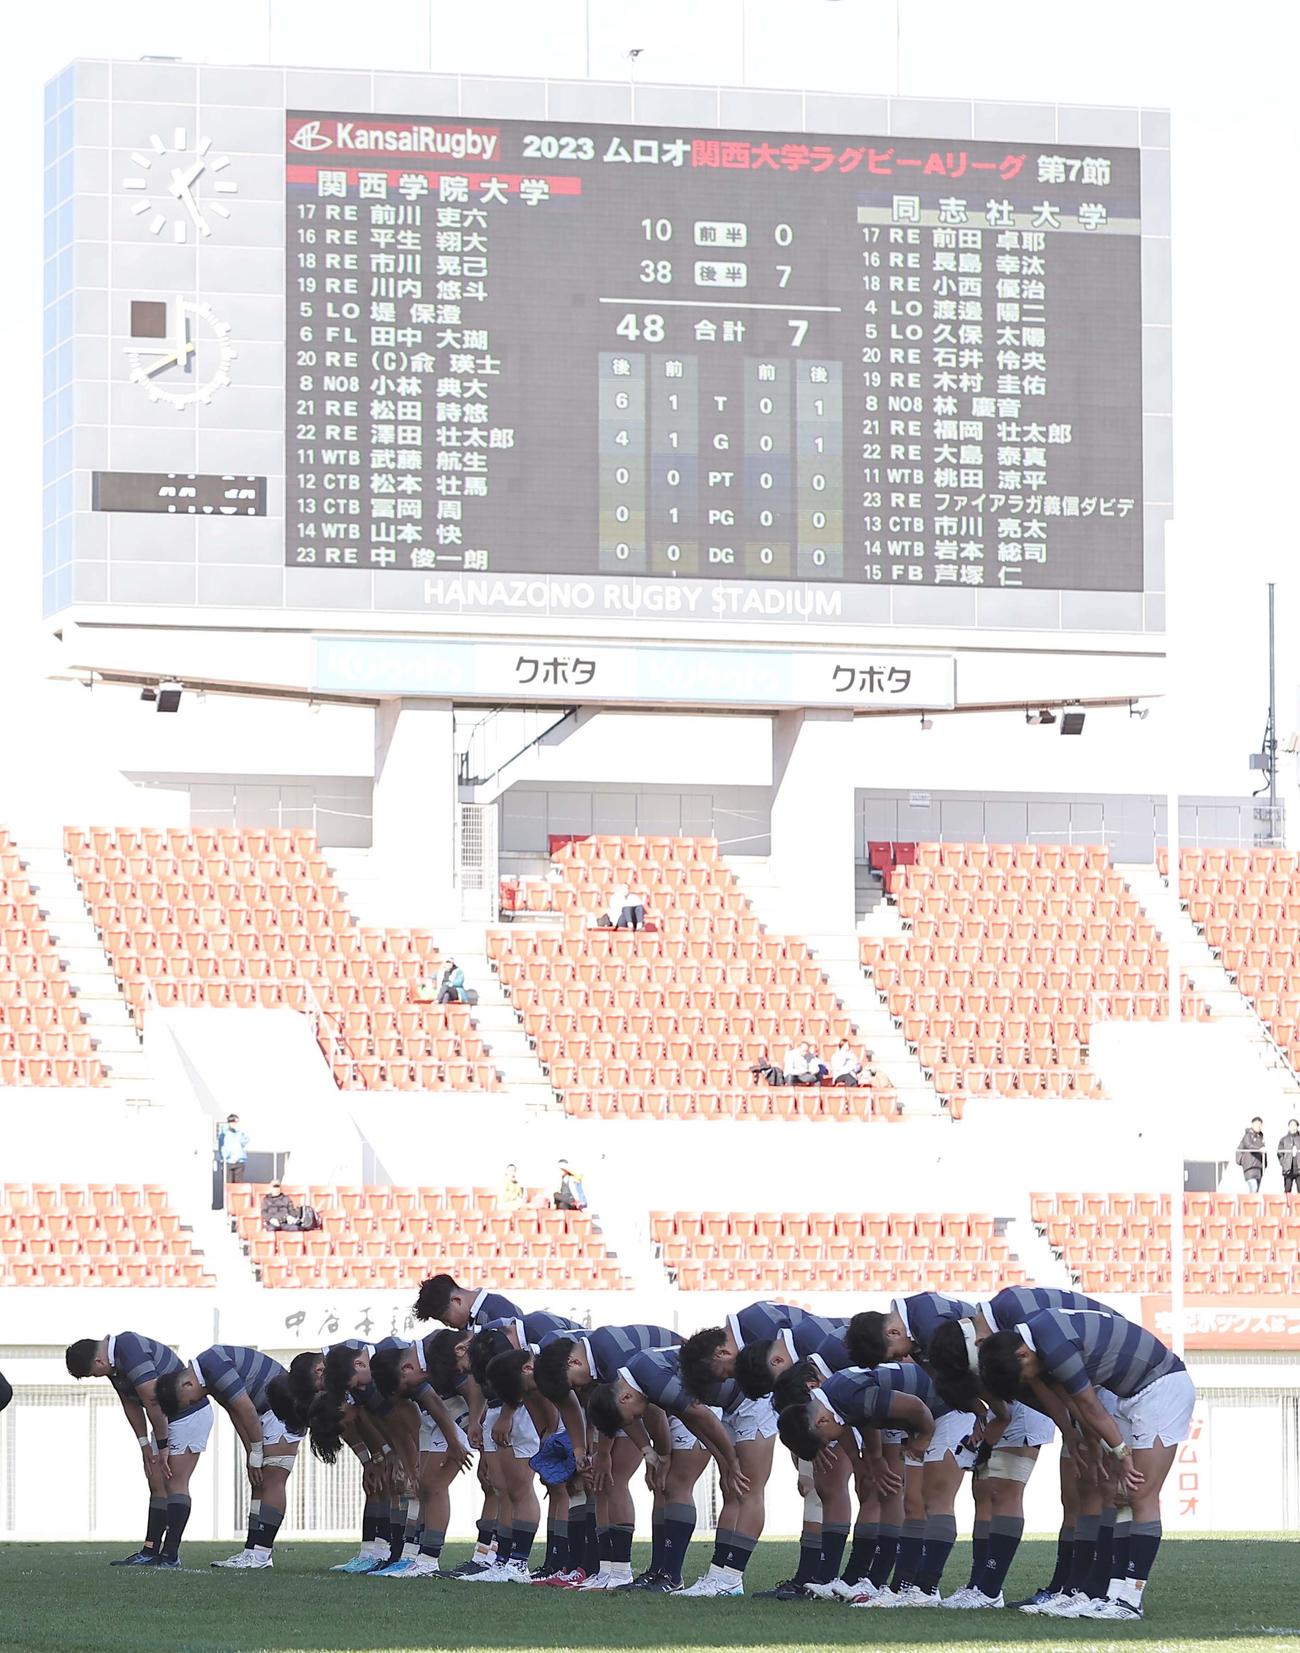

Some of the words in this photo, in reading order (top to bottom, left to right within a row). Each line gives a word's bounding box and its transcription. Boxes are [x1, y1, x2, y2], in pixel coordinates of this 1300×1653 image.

[337, 124, 497, 159] KansaiRugby
[522, 134, 595, 161] 2023
[1036, 154, 1111, 186] 第7節
[317, 170, 549, 206] 関西学院大学
[297, 203, 316, 219] 17
[325, 204, 358, 221] RE
[369, 203, 421, 226] 前川
[892, 195, 1107, 229] 同志社大学
[297, 228, 316, 244] 16
[325, 228, 358, 245] RE
[369, 228, 422, 251] 平生
[435, 231, 488, 253] 翔大
[641, 218, 672, 242] 10
[700, 226, 743, 244] 前半
[774, 223, 793, 246] 0
[862, 227, 880, 243] 17
[889, 227, 920, 244] RE
[932, 227, 983, 250] 前田
[297, 252, 316, 269] 18
[325, 253, 358, 270] RE
[369, 252, 421, 275] 市川
[862, 251, 881, 268] 16
[889, 251, 921, 269] RE
[639, 259, 672, 284] 38
[699, 266, 743, 283] 後半
[775, 265, 792, 288] 7
[297, 277, 316, 293] 19
[325, 277, 358, 294] RE
[370, 276, 422, 299] 川内
[862, 275, 881, 291] 18
[889, 275, 921, 292] RE
[932, 275, 983, 298] 小西
[300, 301, 313, 318] 5
[326, 302, 360, 319] LO
[864, 299, 878, 315] 4
[890, 299, 923, 317] LO
[299, 326, 313, 342] 6
[326, 326, 358, 343] FL
[370, 326, 422, 348] 田中
[616, 313, 665, 342] 48
[694, 319, 746, 342] 合計
[788, 319, 809, 347] 7
[865, 323, 878, 339] 5
[890, 323, 923, 341] LO
[932, 323, 983, 345] 久保
[996, 325, 1046, 348] 太陽
[296, 350, 317, 366] 20
[325, 351, 358, 368] RE
[862, 347, 881, 363] 20
[889, 347, 921, 365] RE
[932, 347, 984, 369] 石井
[612, 358, 630, 376] 後
[665, 360, 683, 377] 前
[758, 363, 776, 381] 前
[810, 366, 828, 383] 後
[299, 375, 313, 391] 8
[323, 375, 360, 392] NO8
[369, 374, 423, 397] 小林
[436, 377, 488, 399] 典大
[863, 371, 881, 387] 19
[890, 372, 921, 389] RE
[933, 371, 984, 393] 木村
[996, 373, 1047, 396] 圭佑
[296, 399, 314, 416] 21
[325, 400, 358, 417] RE
[369, 399, 422, 422] 松田
[615, 392, 628, 409] 6
[669, 394, 678, 410] 1
[713, 395, 728, 412] T
[759, 397, 773, 414] 0
[814, 400, 823, 416] 1
[865, 395, 878, 411] 8
[888, 395, 923, 413] NO8
[932, 394, 958, 416] 林
[296, 424, 316, 440] 22
[325, 424, 358, 441] RE
[435, 425, 514, 449] 壮太郎
[615, 430, 629, 446] 4
[669, 432, 678, 448] 1
[713, 433, 729, 450] G
[760, 435, 773, 452] 0
[814, 437, 823, 453] 1
[862, 419, 879, 435] 21
[890, 419, 922, 437] RE
[933, 418, 983, 441] 福岡
[996, 421, 1072, 445] 壮太郎
[297, 448, 314, 465] 11
[321, 449, 361, 466] WTB
[369, 448, 423, 470] 武藤
[436, 450, 488, 473] 航生
[862, 443, 882, 459] 22
[890, 444, 922, 461] RE
[933, 443, 984, 465] 大島
[297, 473, 316, 489] 12
[323, 473, 361, 490] CTB
[370, 472, 423, 495] 松本
[436, 474, 488, 497] 壮馬
[616, 468, 629, 484] 0
[667, 469, 680, 486] 0
[708, 471, 734, 487] PT
[760, 472, 773, 489] 0
[812, 474, 825, 491] 0
[863, 467, 880, 484] 11
[886, 468, 924, 485] WTB
[933, 467, 984, 489] 桃田
[998, 469, 1047, 491] 涼平
[297, 498, 316, 514] 13
[323, 498, 360, 515] CTB
[436, 499, 462, 520] 周
[863, 491, 882, 508] 23
[890, 492, 922, 508] RE
[616, 505, 629, 522] 0
[669, 507, 678, 523] 1
[708, 509, 734, 526] PG
[760, 510, 773, 527] 0
[812, 512, 826, 528] 0
[863, 516, 882, 532] 13
[888, 516, 924, 533] CTB
[933, 515, 983, 538] 市川
[297, 522, 316, 538] 14
[321, 522, 361, 539] WTB
[370, 521, 423, 544] 山本
[436, 523, 463, 545] 快
[296, 546, 316, 563] 23
[325, 547, 358, 564] RE
[370, 546, 396, 568] 中
[410, 547, 488, 571] 俊一朗
[616, 543, 629, 560] 0
[667, 544, 680, 561] 0
[709, 547, 734, 564] DG
[760, 547, 773, 564] 0
[813, 549, 826, 566] 0
[864, 540, 882, 556] 14
[887, 540, 925, 557] WTB
[934, 539, 985, 562] 岩本
[864, 564, 882, 580] 15
[891, 564, 923, 581] FB
[998, 565, 1023, 586] 仁
[423, 579, 595, 609] HANAZONO
[604, 584, 703, 611] RUGBY
[712, 588, 842, 615] STADIUM
[516, 656, 596, 685] クボタ
[832, 665, 911, 694] クボタ
[1178, 1445, 1199, 1515] ムロオ
